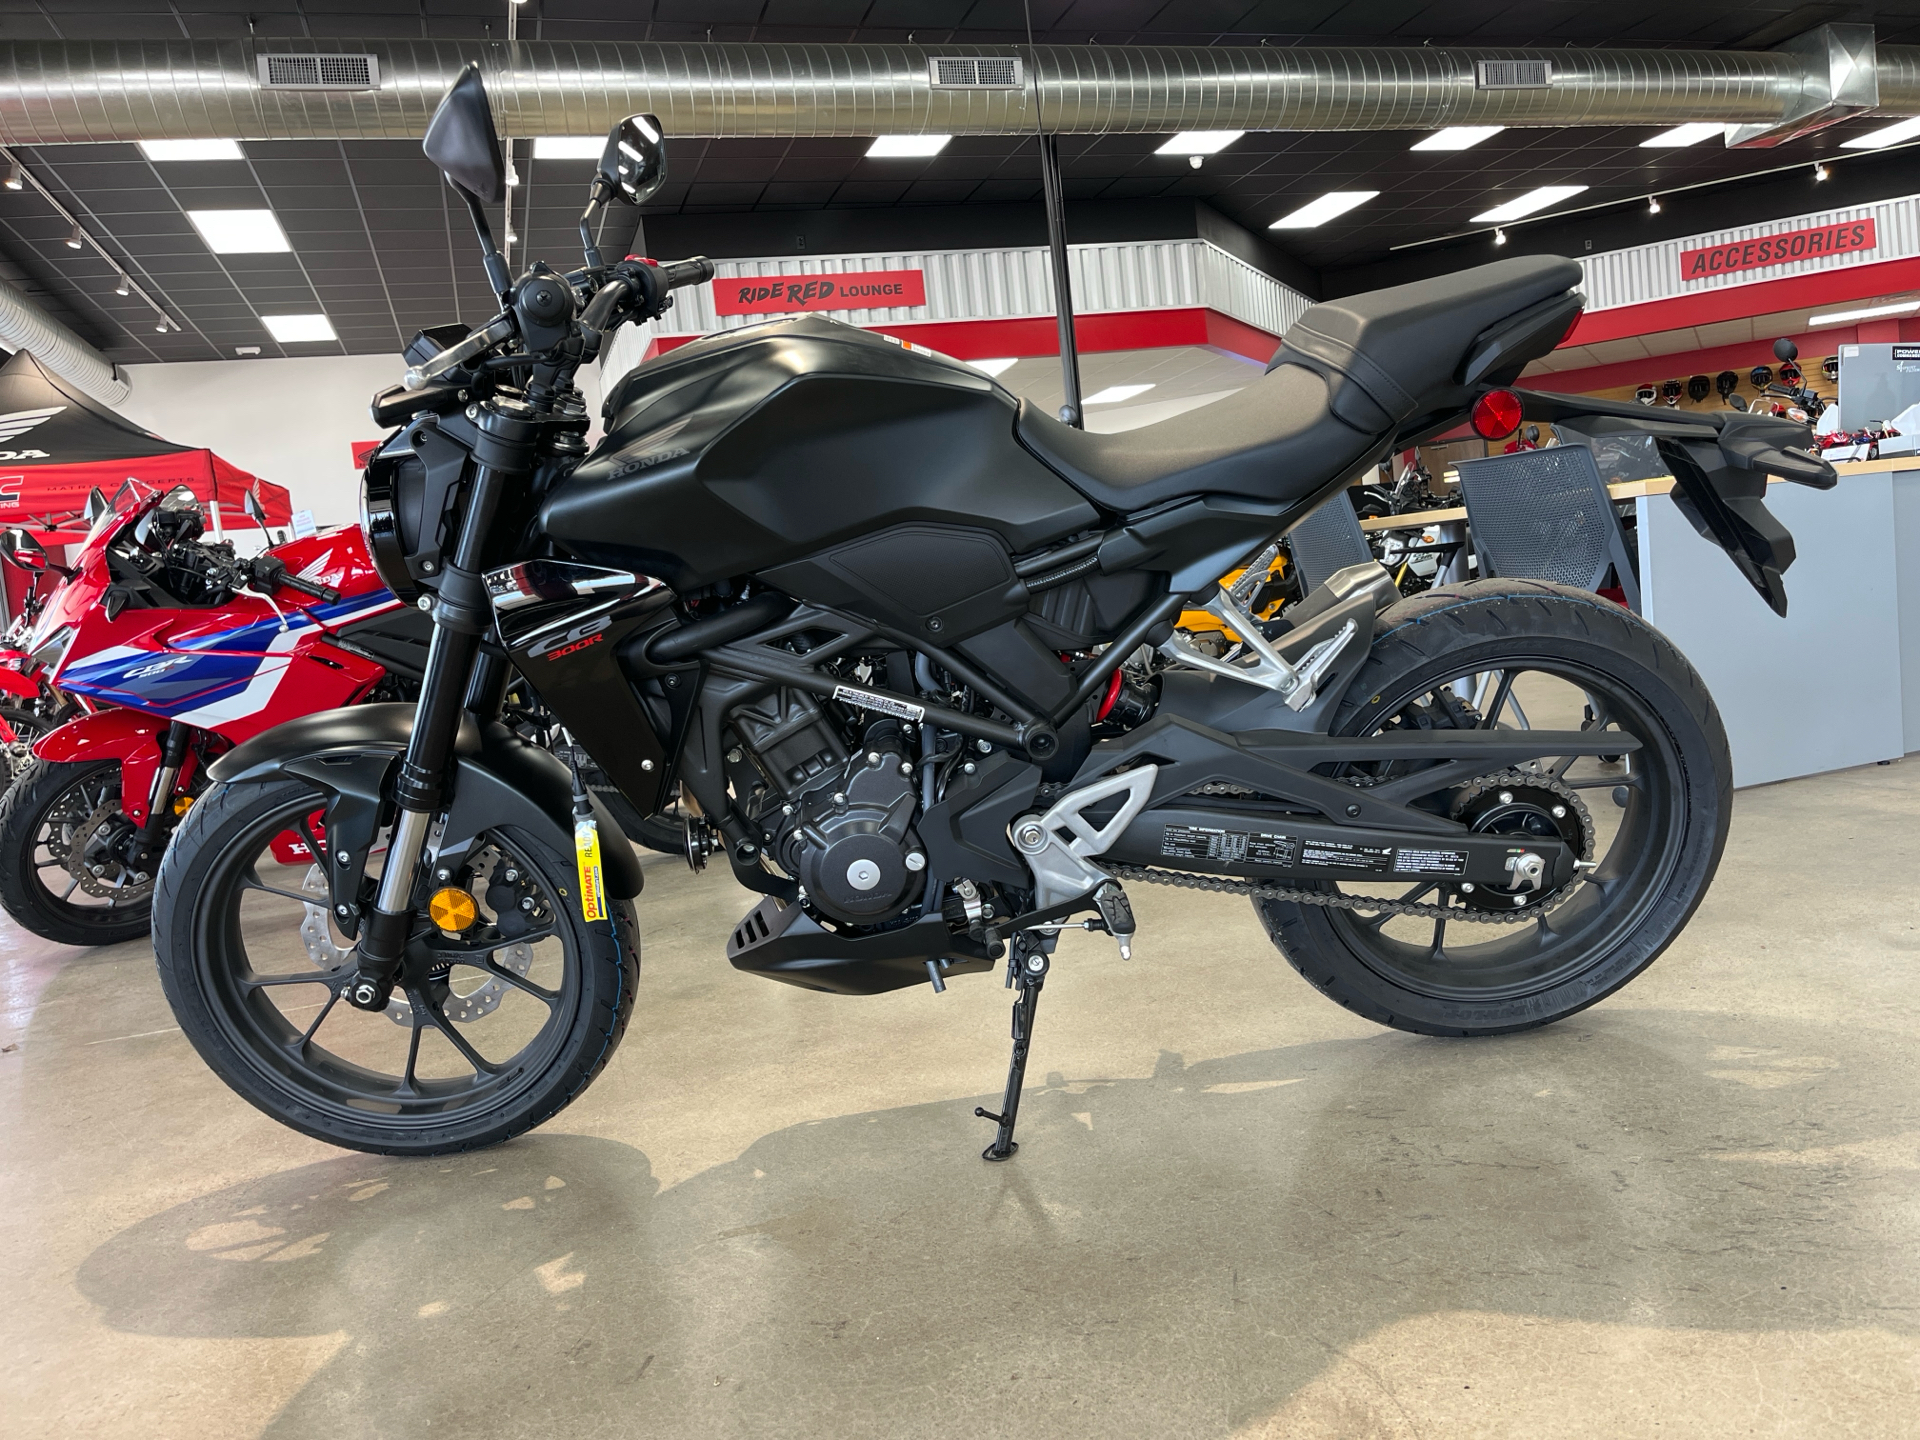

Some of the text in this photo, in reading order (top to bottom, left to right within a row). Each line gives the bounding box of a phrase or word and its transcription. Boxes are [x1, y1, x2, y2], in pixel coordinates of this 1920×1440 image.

[1691, 225, 1865, 275] ACCESSORIES
[738, 280, 903, 306] RIDE RED LOUNGE
[607, 446, 691, 480] HONDA
[547, 632, 604, 662] 300R
[583, 866, 597, 919] OptiMATE
